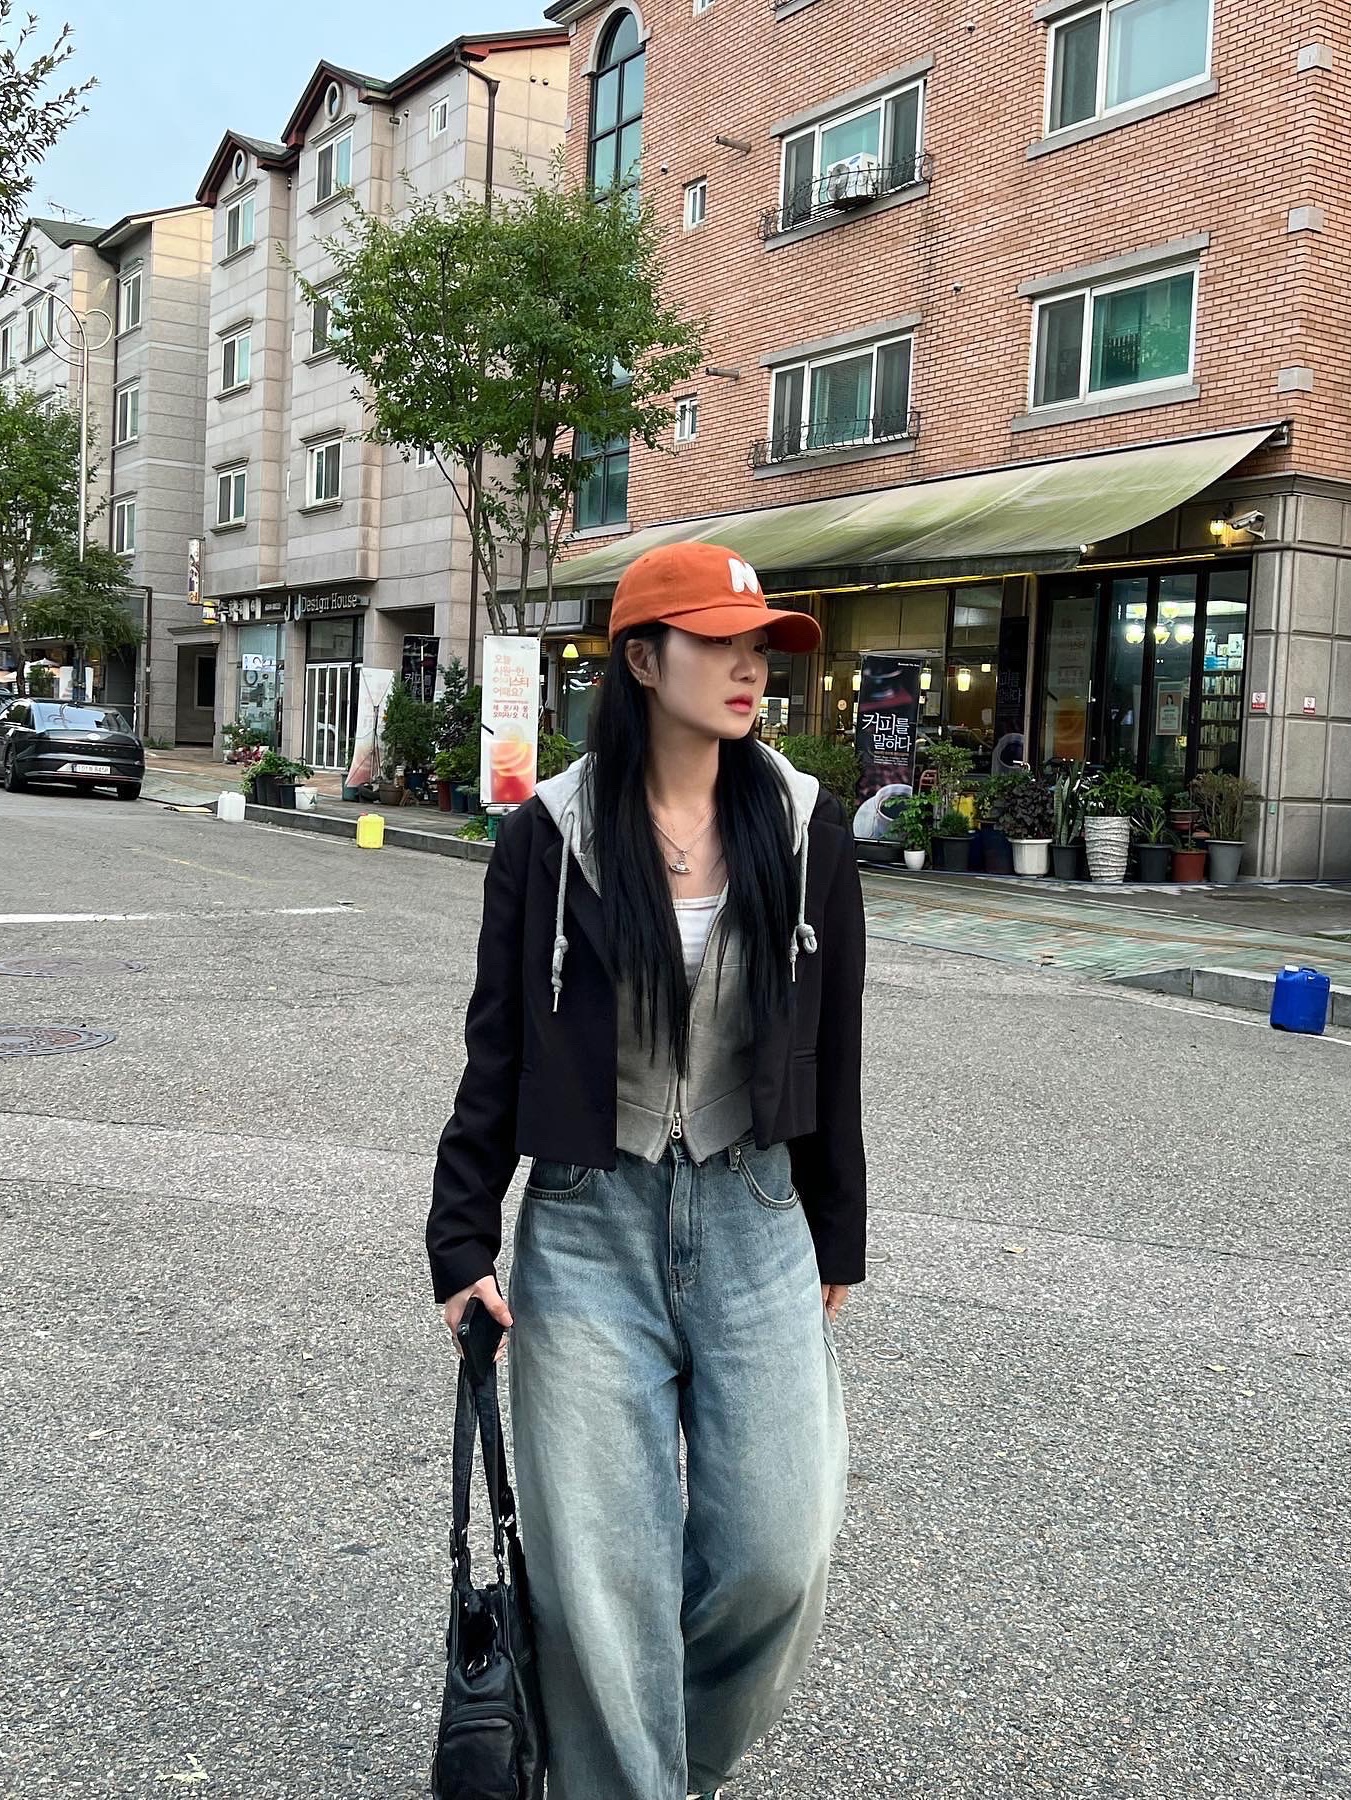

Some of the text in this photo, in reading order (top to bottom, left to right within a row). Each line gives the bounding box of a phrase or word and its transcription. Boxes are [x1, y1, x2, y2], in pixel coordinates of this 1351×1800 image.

[301, 594, 329, 613] Design
[331, 592, 358, 609] House
[861, 712, 910, 735] 커피를
[873, 733, 912, 752] 말하다
